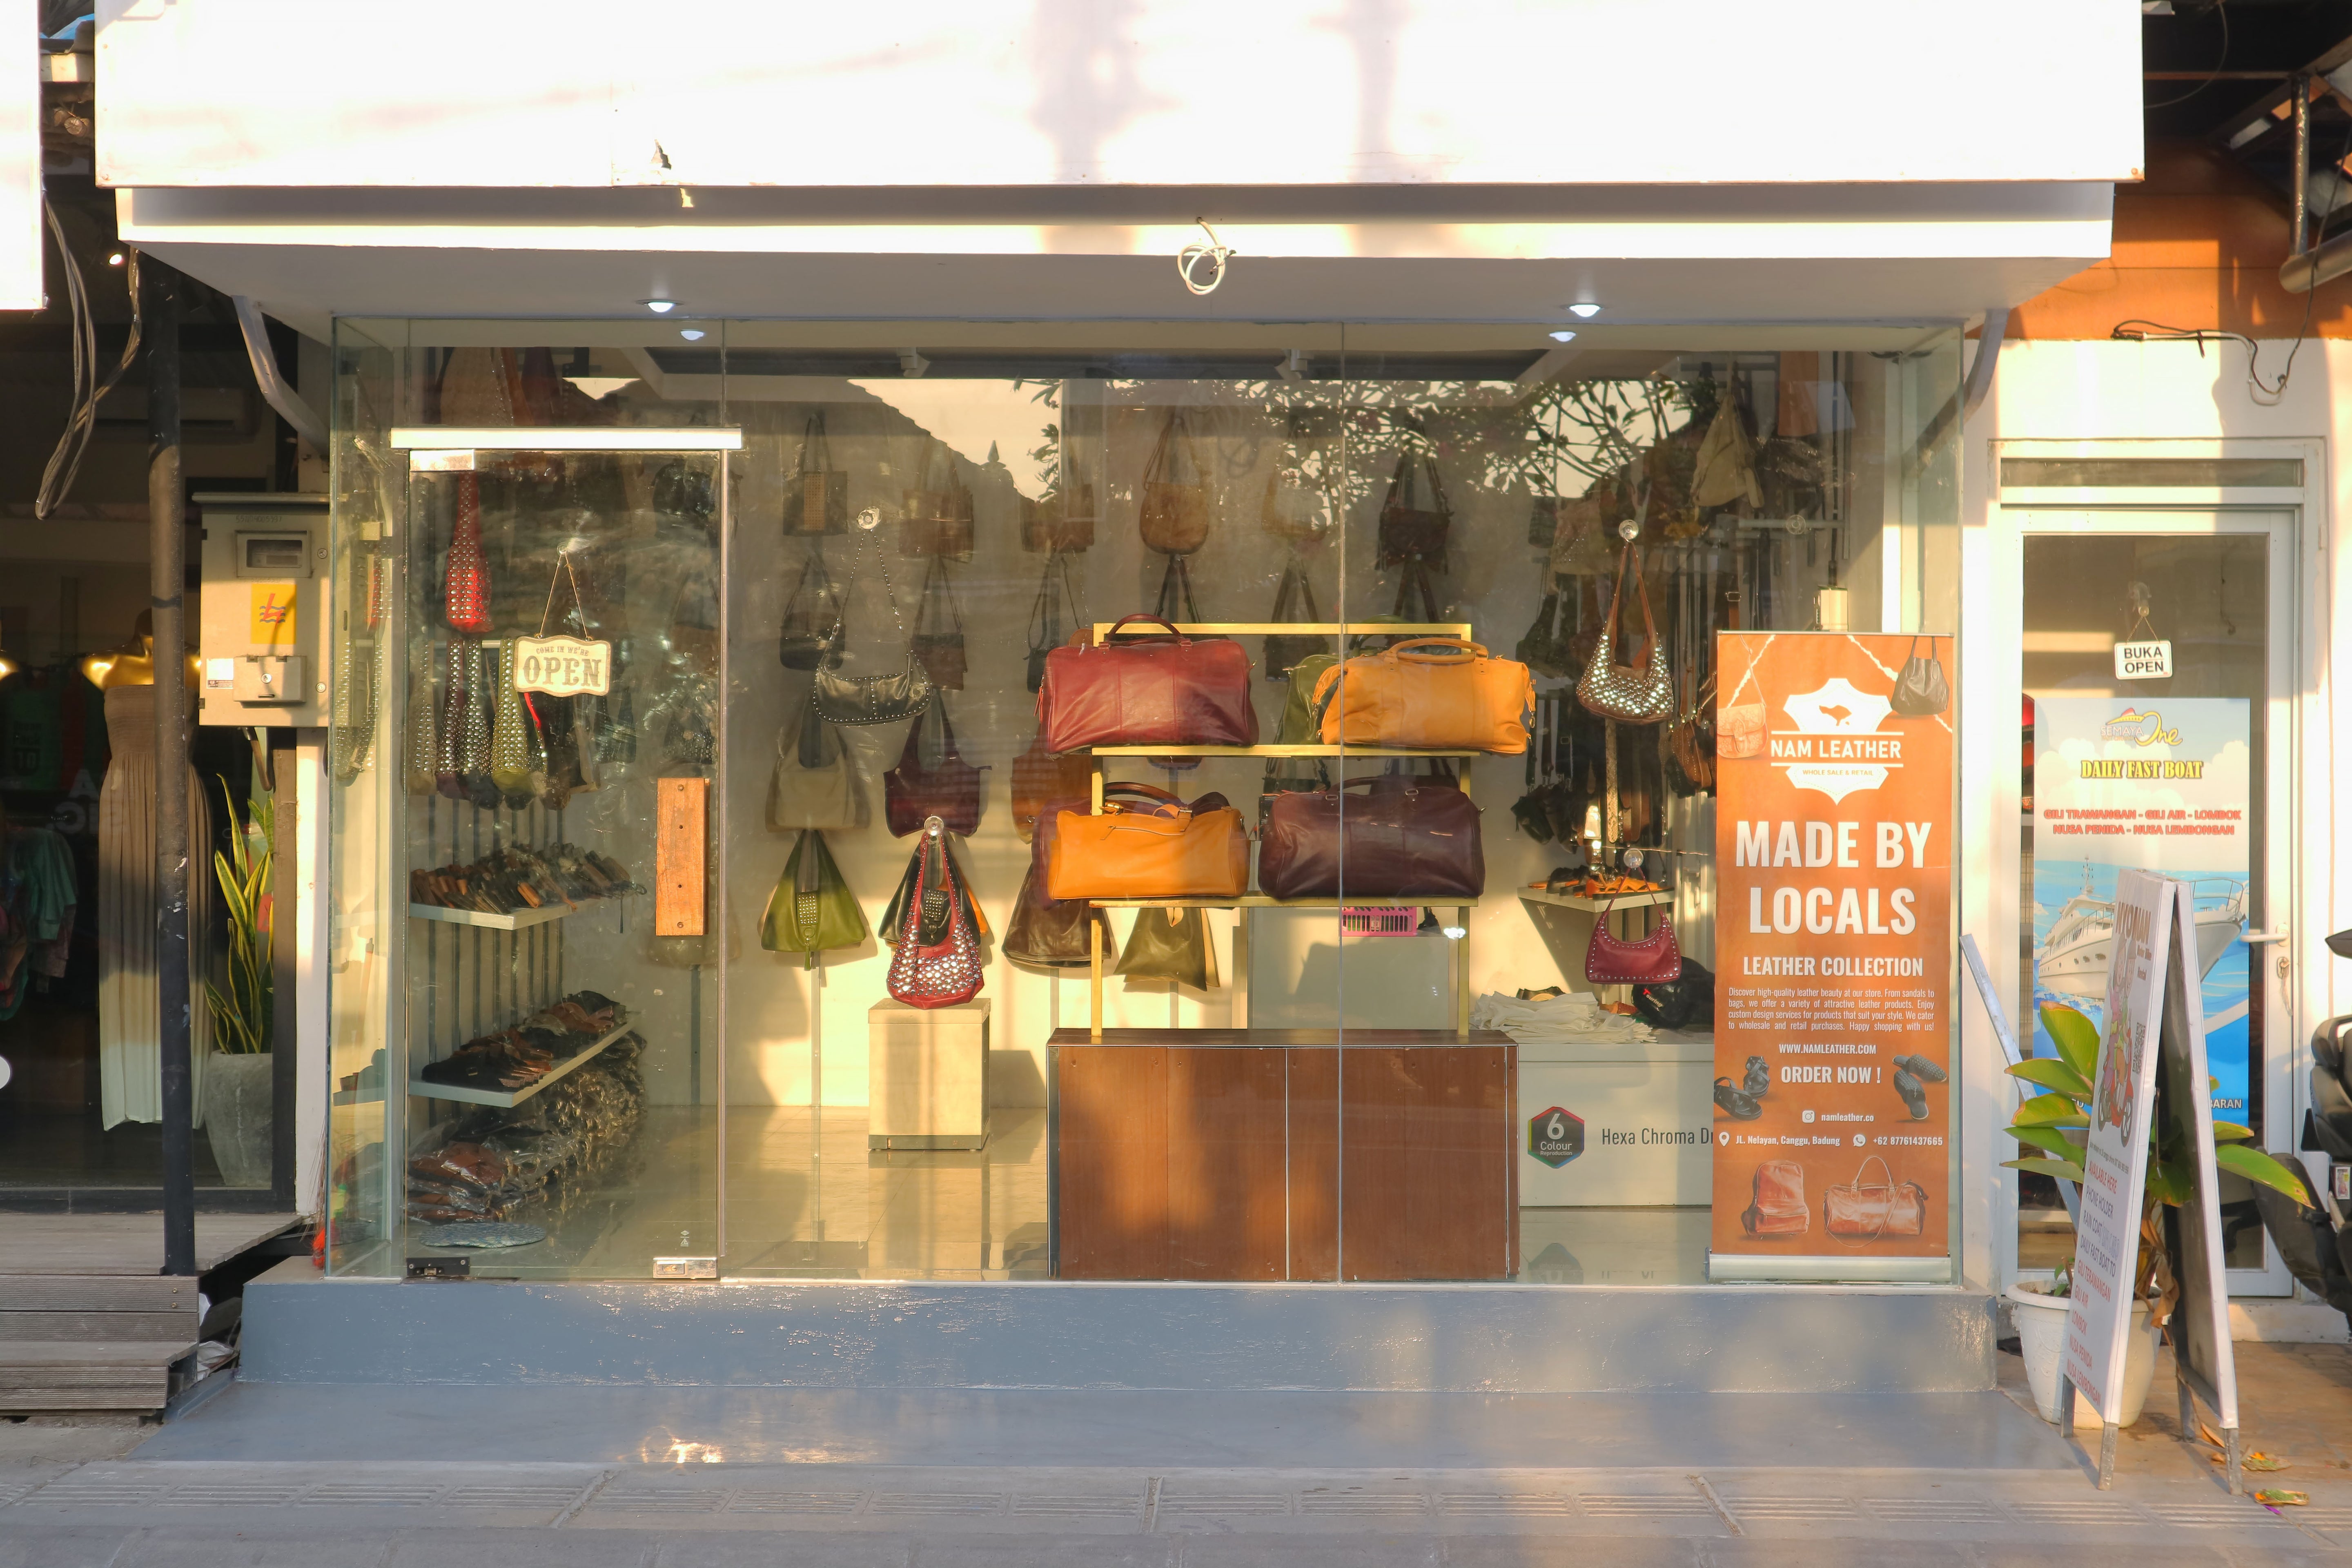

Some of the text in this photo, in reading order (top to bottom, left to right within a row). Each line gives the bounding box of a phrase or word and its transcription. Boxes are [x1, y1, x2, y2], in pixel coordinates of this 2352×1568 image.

[568, 646, 589, 656] WE'RE
[2124, 646, 2163, 659] BUKA
[523, 655, 601, 687] OPEN
[2125, 661, 2164, 674] OPEN
[2101, 711, 2183, 746] SEMAYA One
[1771, 739, 1901, 759] NAM LEATHER
[2081, 760, 2203, 779] DAILY FAST BOAT
[2044, 809, 2064, 820] GILI
[2066, 809, 2137, 820] TRAWANGAN
[2145, 809, 2165, 820] GILI
[2167, 809, 2186, 820] AIR
[2194, 810, 2242, 820] LOMBOK
[2053, 824, 2083, 835] NUSA
[2085, 824, 2125, 835] PENIDA
[2134, 825, 2163, 835] NUSA
[2165, 825, 2234, 835] LEMBONGAN
[1736, 820, 1933, 869] MADE BY
[1750, 886, 1916, 935] LOCALS
[1743, 957, 1923, 977] LEATHER COLLECTION
[1643, 988, 1664, 1008] Touring
[1728, 987, 1755, 996] Discover
[1757, 988, 1795, 998] high-quality
[1797, 988, 1819, 997] leather
[1821, 988, 1842, 998] beauty
[1884, 989, 1900, 998] From
[1902, 989, 1926, 998] sandals
[1928, 989, 1935, 998] to
[1728, 999, 1745, 1009] bags,
[1762, 999, 1777, 1007] offer
[1788, 1000, 1810, 1009] variety
[1814, 999, 1820, 1008] of
[1824, 1000, 1855, 1008] attractive
[1858, 1000, 1881, 1009] leather
[1884, 1000, 1913, 1010] products.
[1917, 1000, 1935, 1010] Enjoy
[1753, 1010, 1774, 1020] design
[1803, 1010, 1812, 1019] for
[1813, 1011, 1842, 1020] products
[1843, 1011, 1856, 1019] that
[1858, 1011, 1870, 1020] suit
[1871, 1012, 1886, 1021] your
[1887, 1011, 1904, 1021] style.
[1905, 1011, 1916, 1020] We
[1728, 1021, 1934, 1032] to wholesale and retail purchases. Happy shopping with us!
[1779, 1043, 1877, 1054] WWW.NAMLEATHER.COM
[1781, 1066, 1881, 1084] ORDER NOW !
[1547, 1113, 1564, 1140] 6
[1821, 1113, 1874, 1122] namleather.co
[1602, 1128, 1635, 1145] Hexa
[1641, 1127, 1694, 1145] Chroma
[1748, 1136, 1779, 1145] Nelayan,
[1781, 1136, 1810, 1146] Canggu,
[1812, 1136, 1840, 1146] Badung
[1873, 1137, 1943, 1146] +62 87761437665
[1540, 1141, 1572, 1150] Colour
[2089, 1160, 2107, 1187] AVAILABLE
[2107, 1174, 2117, 1194] HERE
[2086, 1185, 2114, 1219] PHONE HOLDER
[2083, 1210, 2102, 1237] RAIN COAT
[2080, 1234, 2116, 1278] DAILY FAST BOAT TO
[2072, 1309, 2088, 1336] LOMBOK
[2069, 1333, 2093, 1371] NUSA PENIDA
[2067, 1358, 2077, 1381] NUSA
